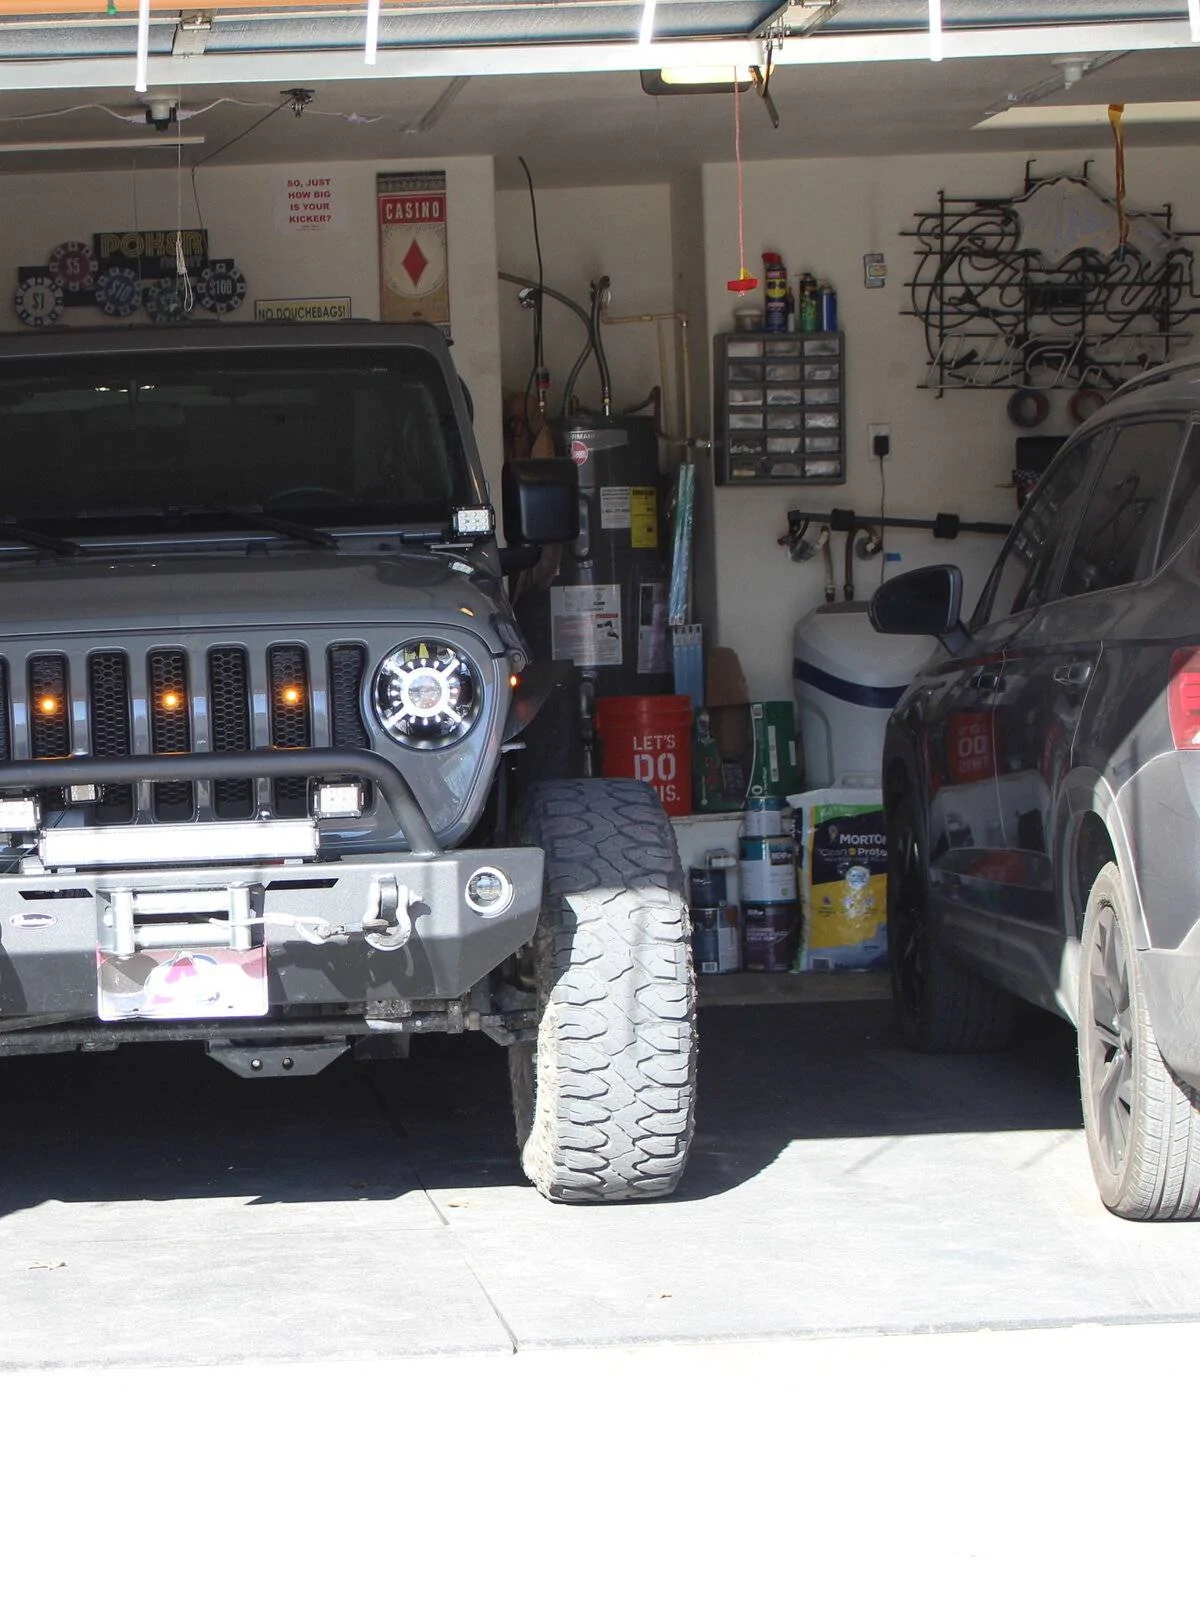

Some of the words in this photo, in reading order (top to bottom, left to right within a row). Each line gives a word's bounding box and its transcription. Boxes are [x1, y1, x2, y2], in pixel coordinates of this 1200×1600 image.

[290, 203, 300, 211] IS
[385, 202, 440, 220] CASINO
[289, 215, 331, 223] KICKER?
[633, 734, 676, 751] LET'S
[634, 753, 676, 782] DO
[653, 785, 680, 802] IS.
[858, 847, 887, 857] Prote
